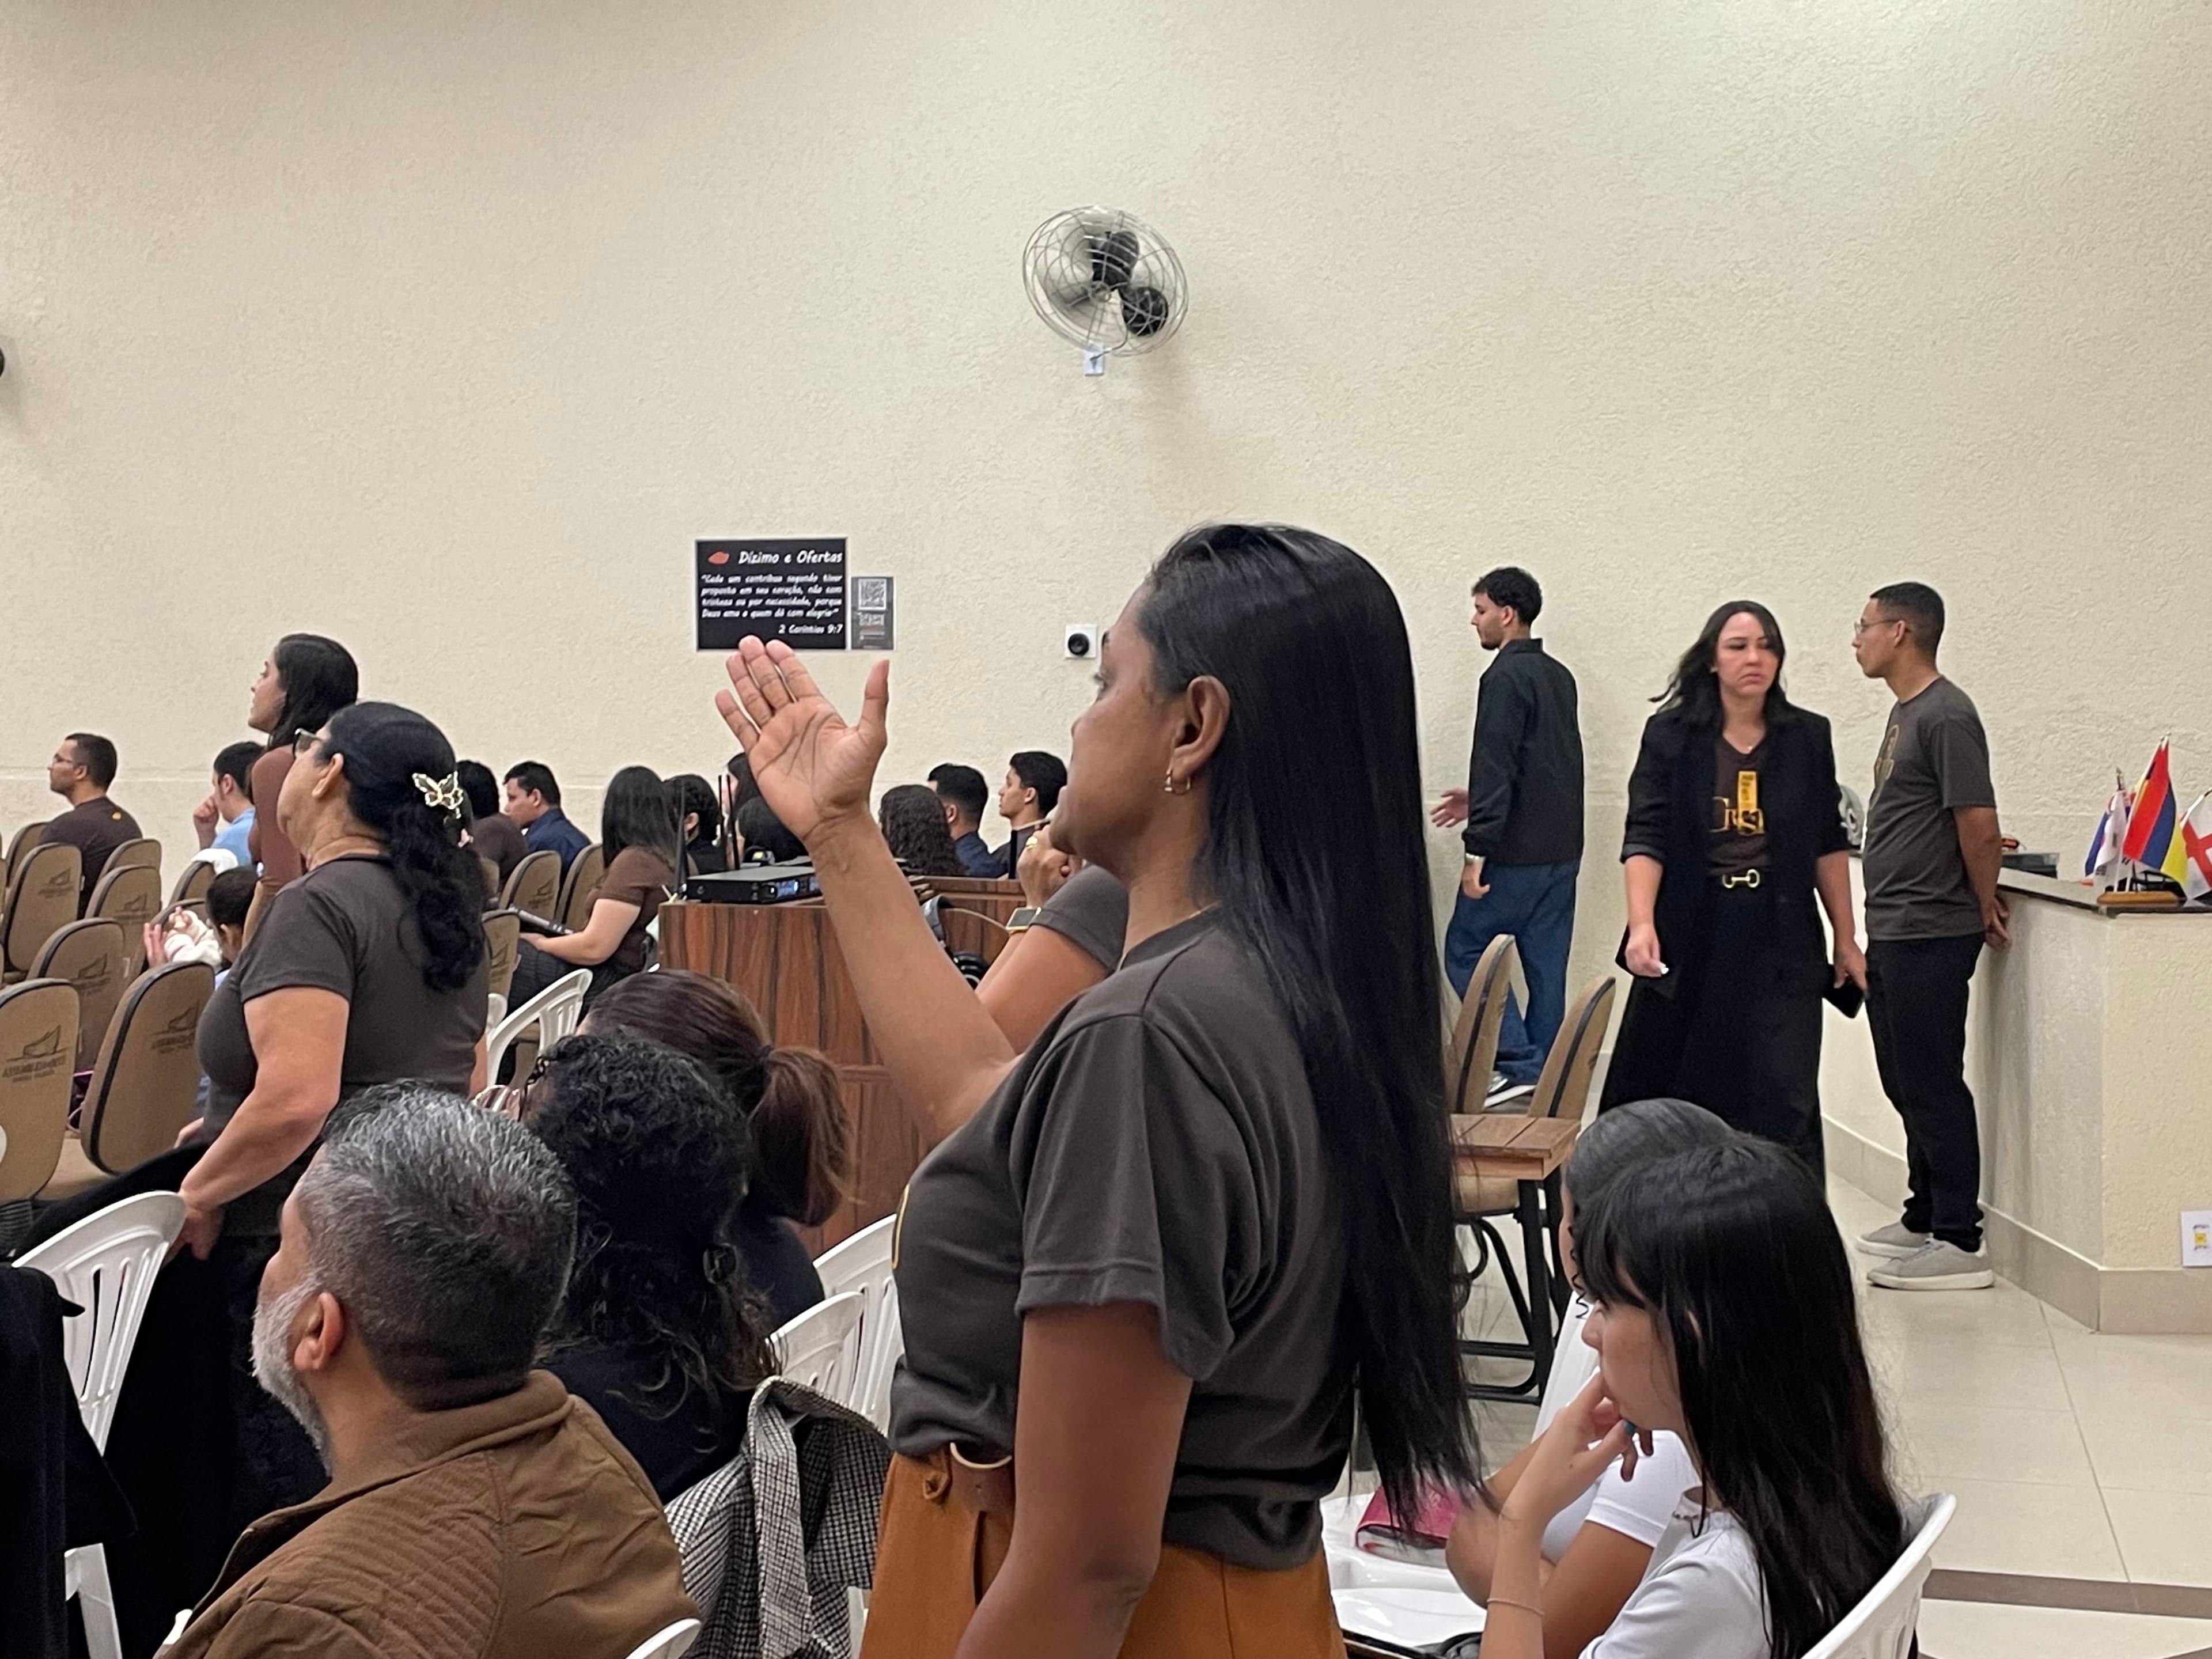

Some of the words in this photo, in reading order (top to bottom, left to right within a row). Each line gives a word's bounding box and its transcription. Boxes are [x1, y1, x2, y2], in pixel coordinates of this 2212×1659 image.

[738, 551, 780, 565] Dízimo
[784, 554, 791, 564] e
[797, 550, 843, 564] Ofertas
[778, 624, 786, 634] 2
[827, 623, 843, 634] 9:7
